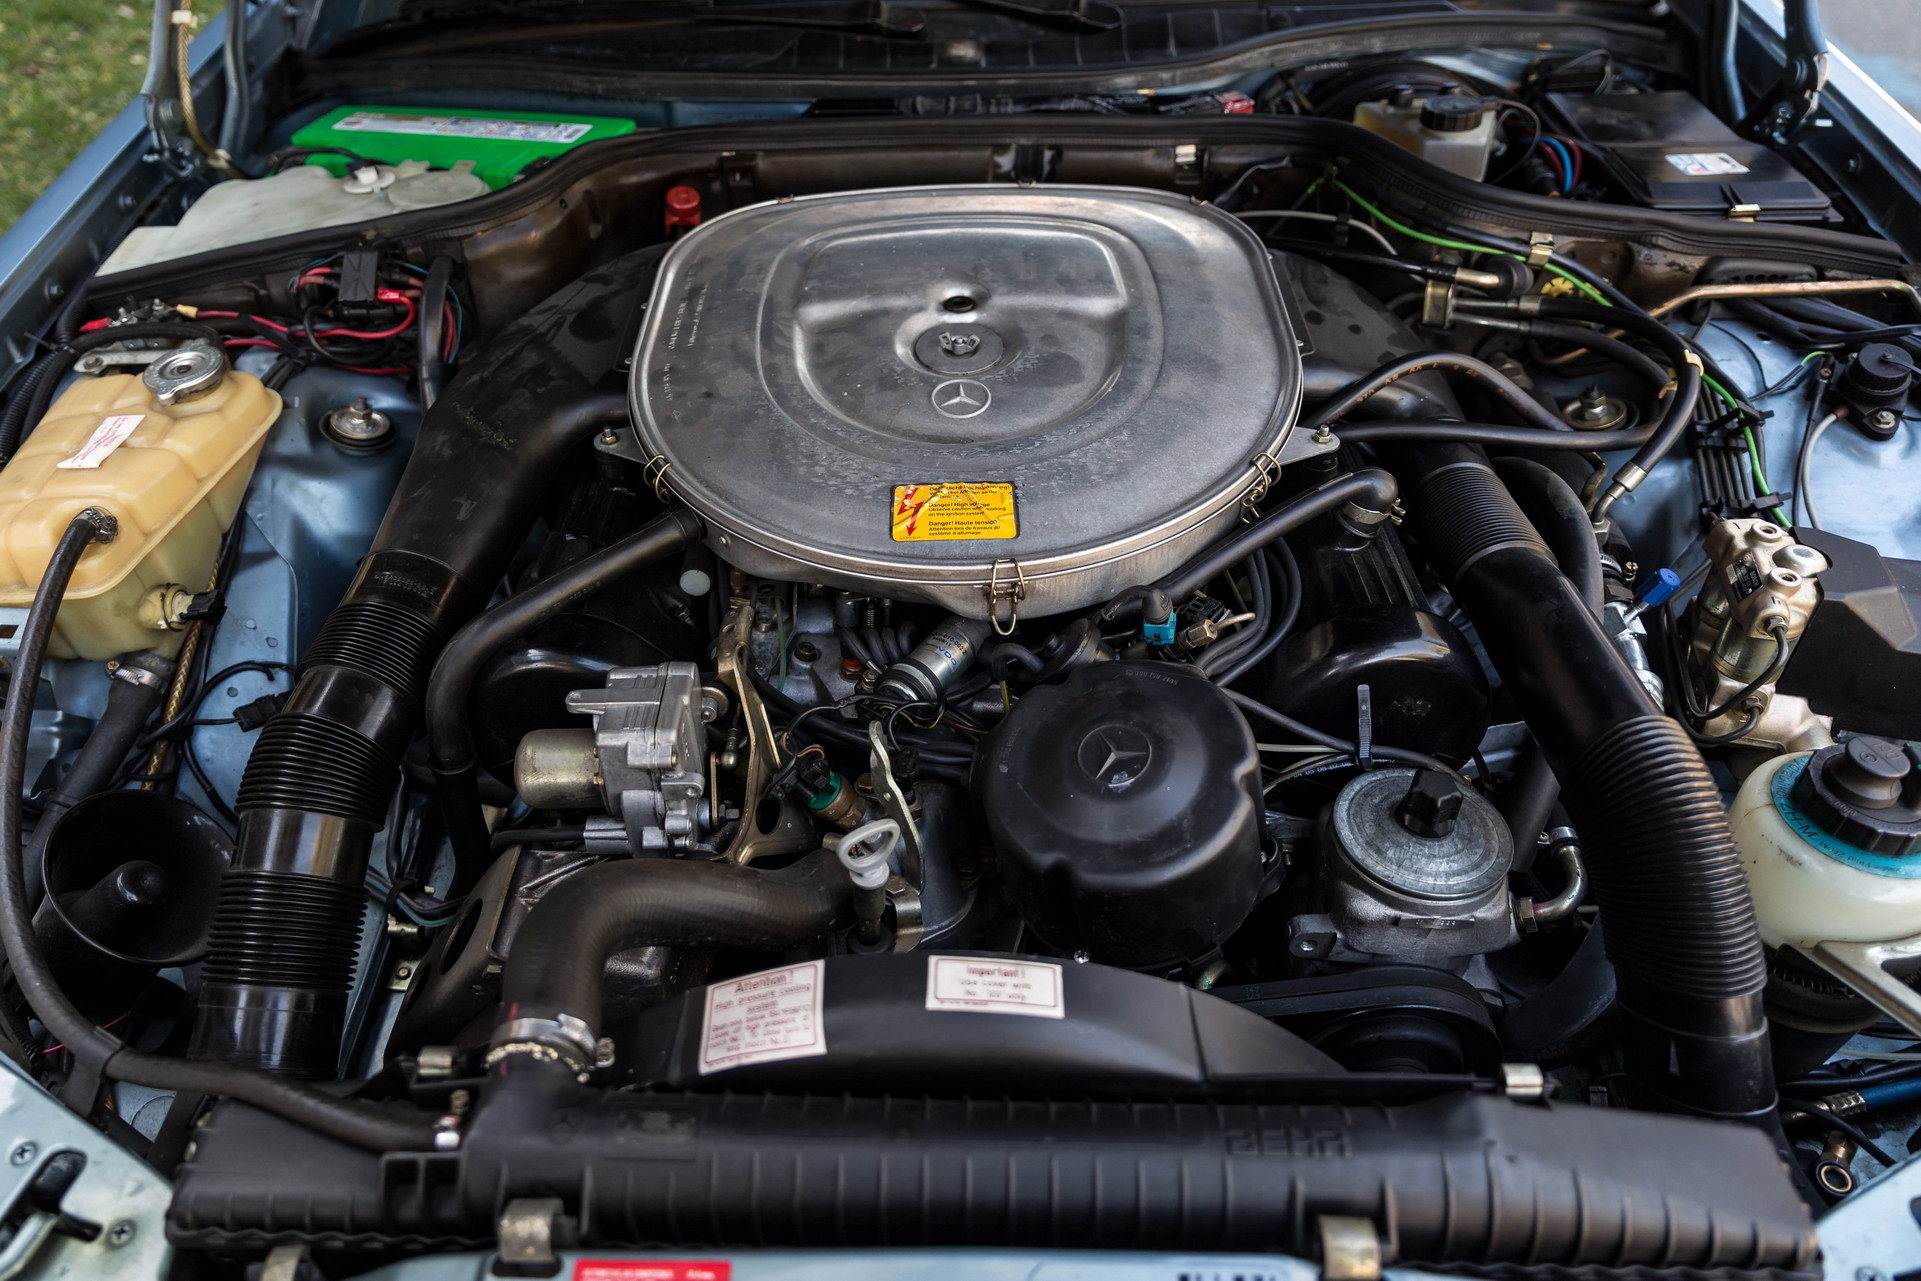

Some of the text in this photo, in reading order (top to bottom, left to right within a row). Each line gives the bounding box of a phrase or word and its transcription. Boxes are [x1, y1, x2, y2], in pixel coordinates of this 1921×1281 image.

[938, 647, 957, 666] VDO
[967, 966, 1019, 978] Important
[735, 974, 787, 993] Attention
